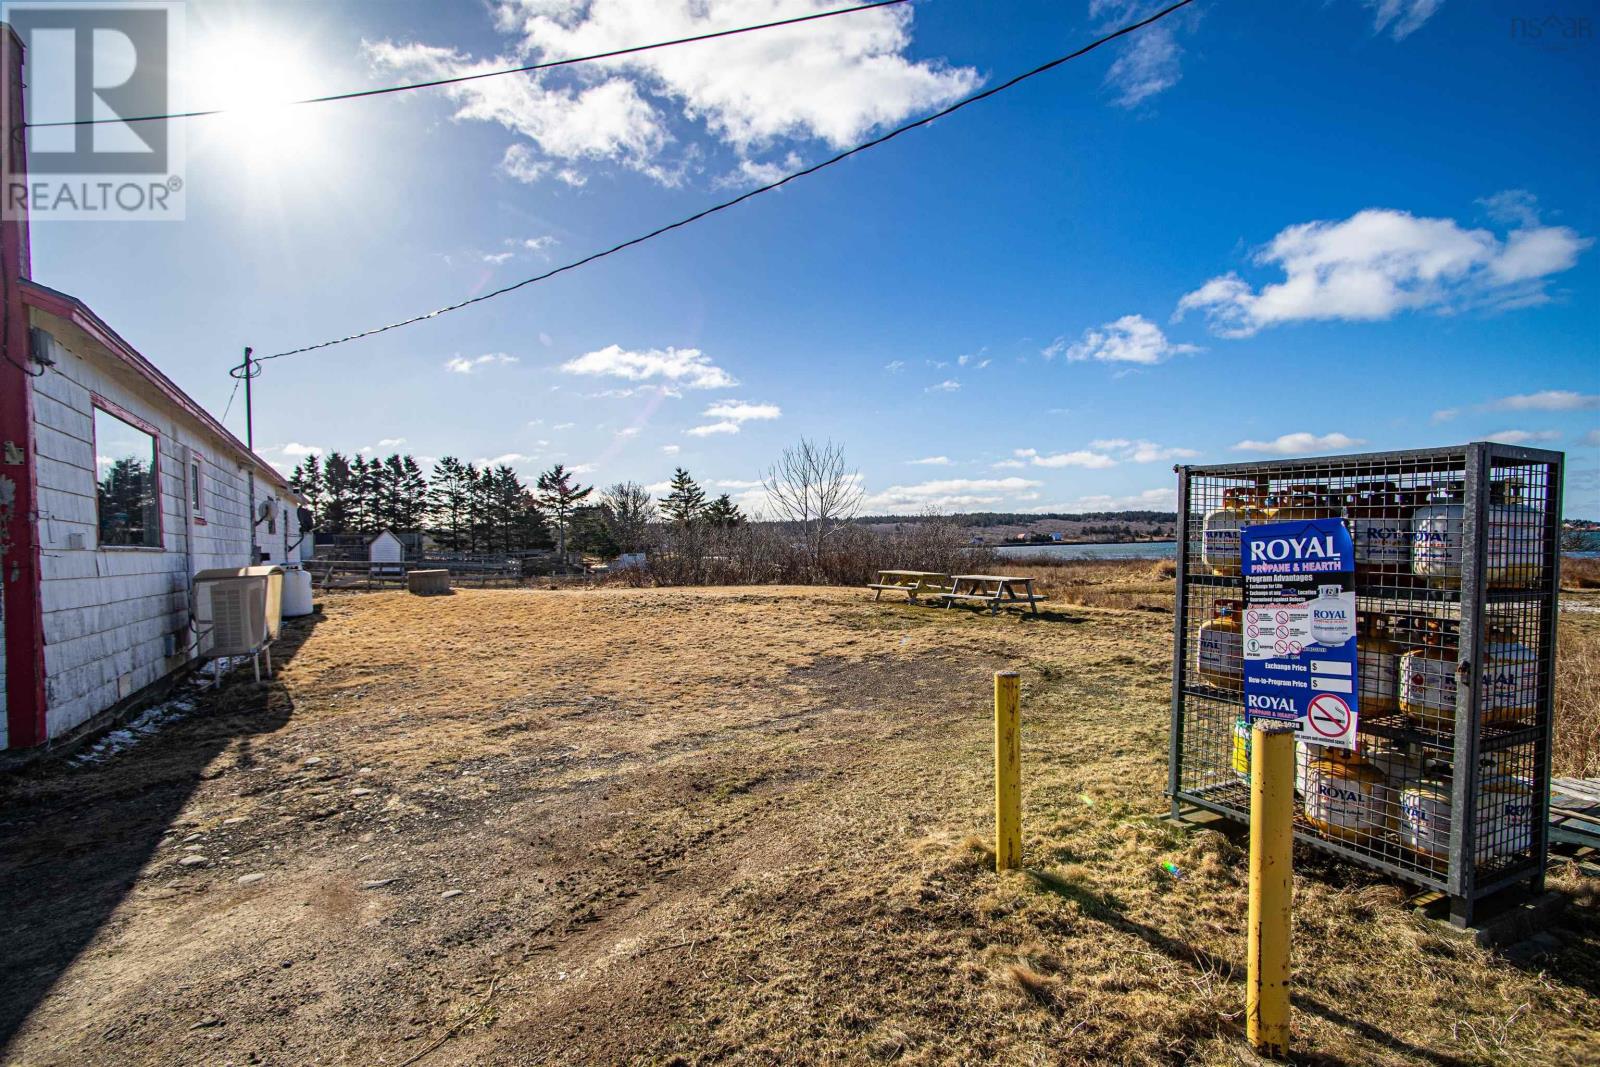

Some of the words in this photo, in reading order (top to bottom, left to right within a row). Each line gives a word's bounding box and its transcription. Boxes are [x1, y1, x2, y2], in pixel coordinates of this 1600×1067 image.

[1250, 536, 1341, 561] ROYAL
[1251, 561, 1290, 573] PROPANE
[1293, 564, 1299, 572] &
[1302, 561, 1341, 572] HEARTH
[1246, 575, 1273, 584] Program
[1273, 574, 1313, 583] Advantages
[1313, 610, 1347, 619] ROYAL
[1265, 662, 1291, 671] Exchange
[1312, 662, 1318, 671] $
[1292, 679, 1308, 688] Price
[1312, 679, 1318, 688] $
[1248, 694, 1299, 712] ROYAL
[1319, 785, 1365, 802] ROYAL
